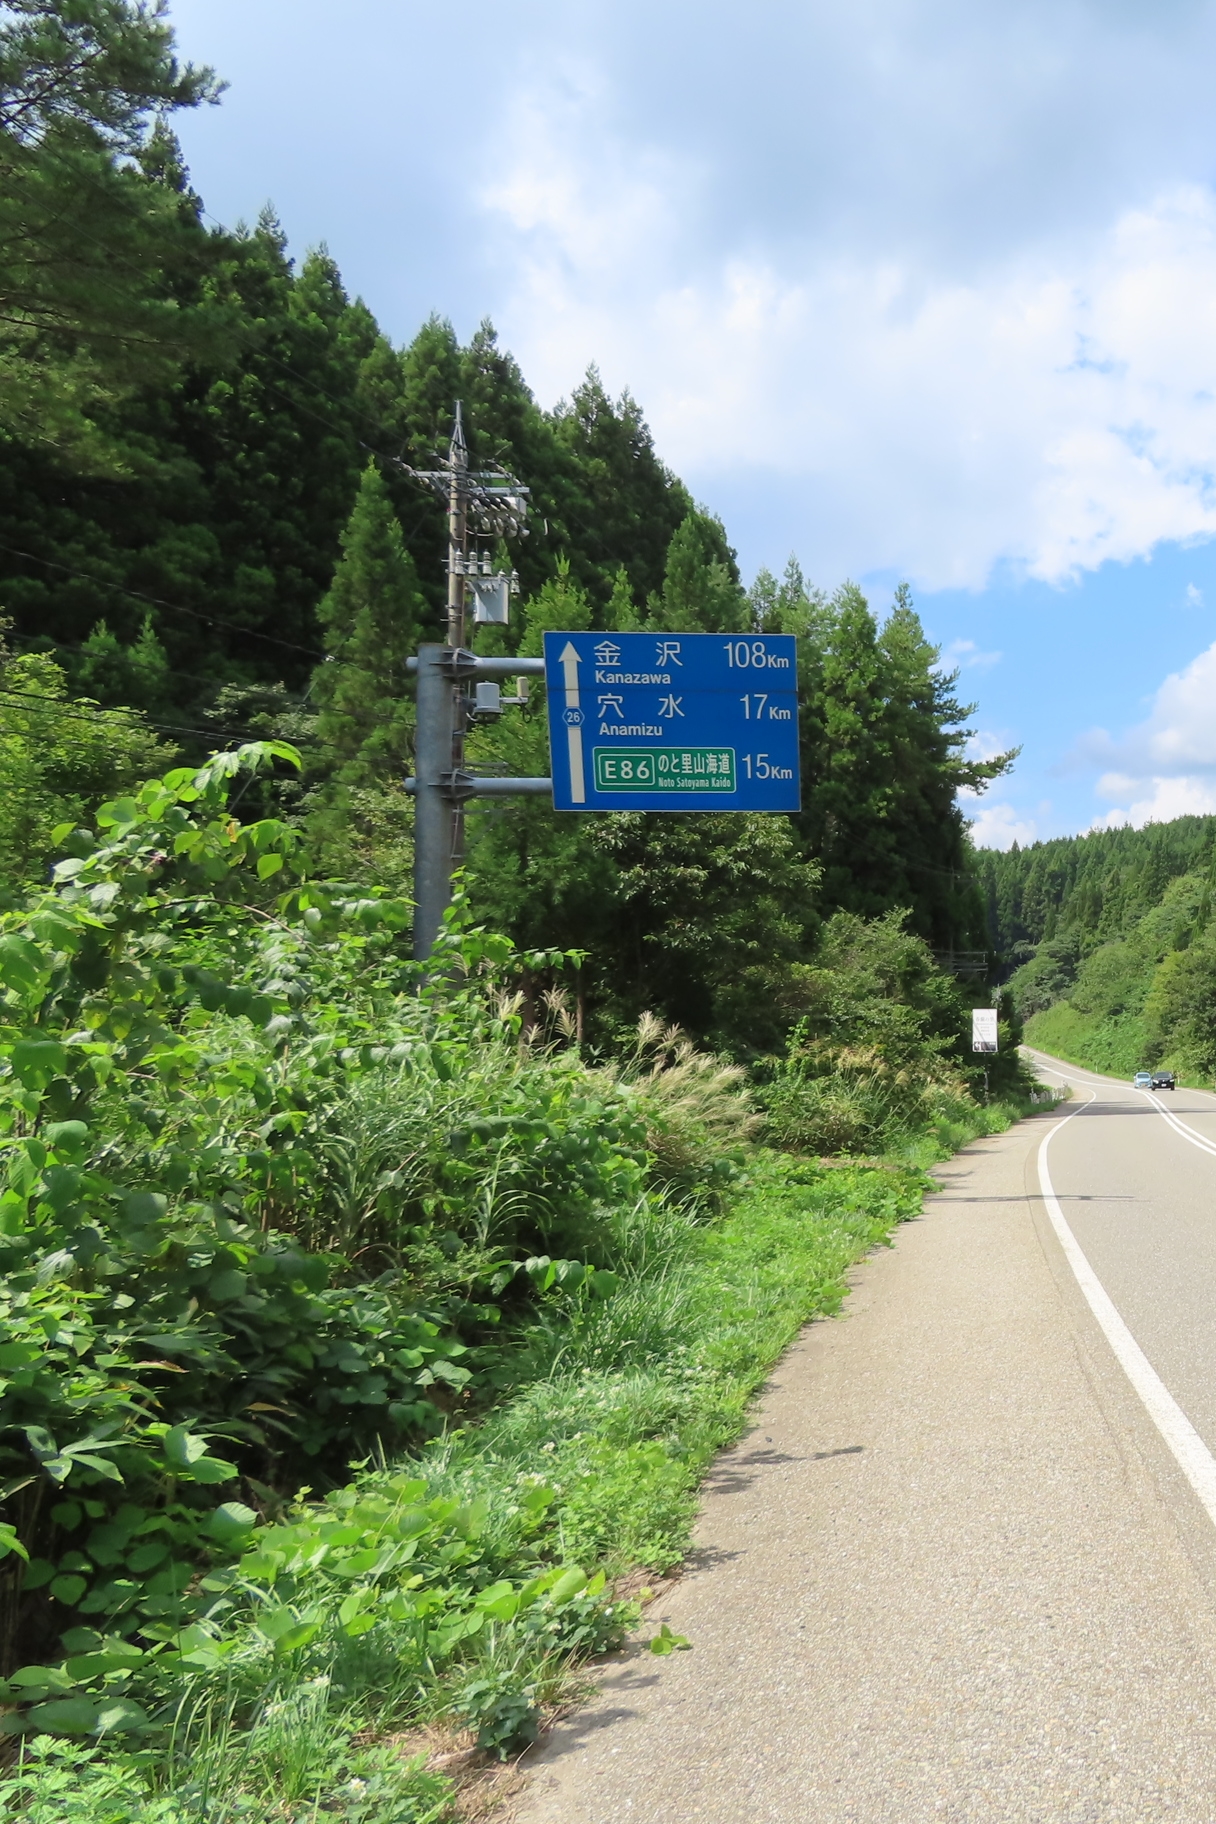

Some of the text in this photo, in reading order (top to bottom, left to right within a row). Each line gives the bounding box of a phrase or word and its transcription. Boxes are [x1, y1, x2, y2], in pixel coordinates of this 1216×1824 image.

[593, 640, 683, 667] 金沢
[595, 670, 671, 685] Kanazawa
[597, 693, 685, 719] 穴水
[566, 711, 581, 723] 26
[599, 722, 663, 736] Anamizu
[604, 760, 650, 779] E86
[658, 753, 731, 774] のと里山海道
[658, 776, 731, 790] Noto Satoyama Kaido
